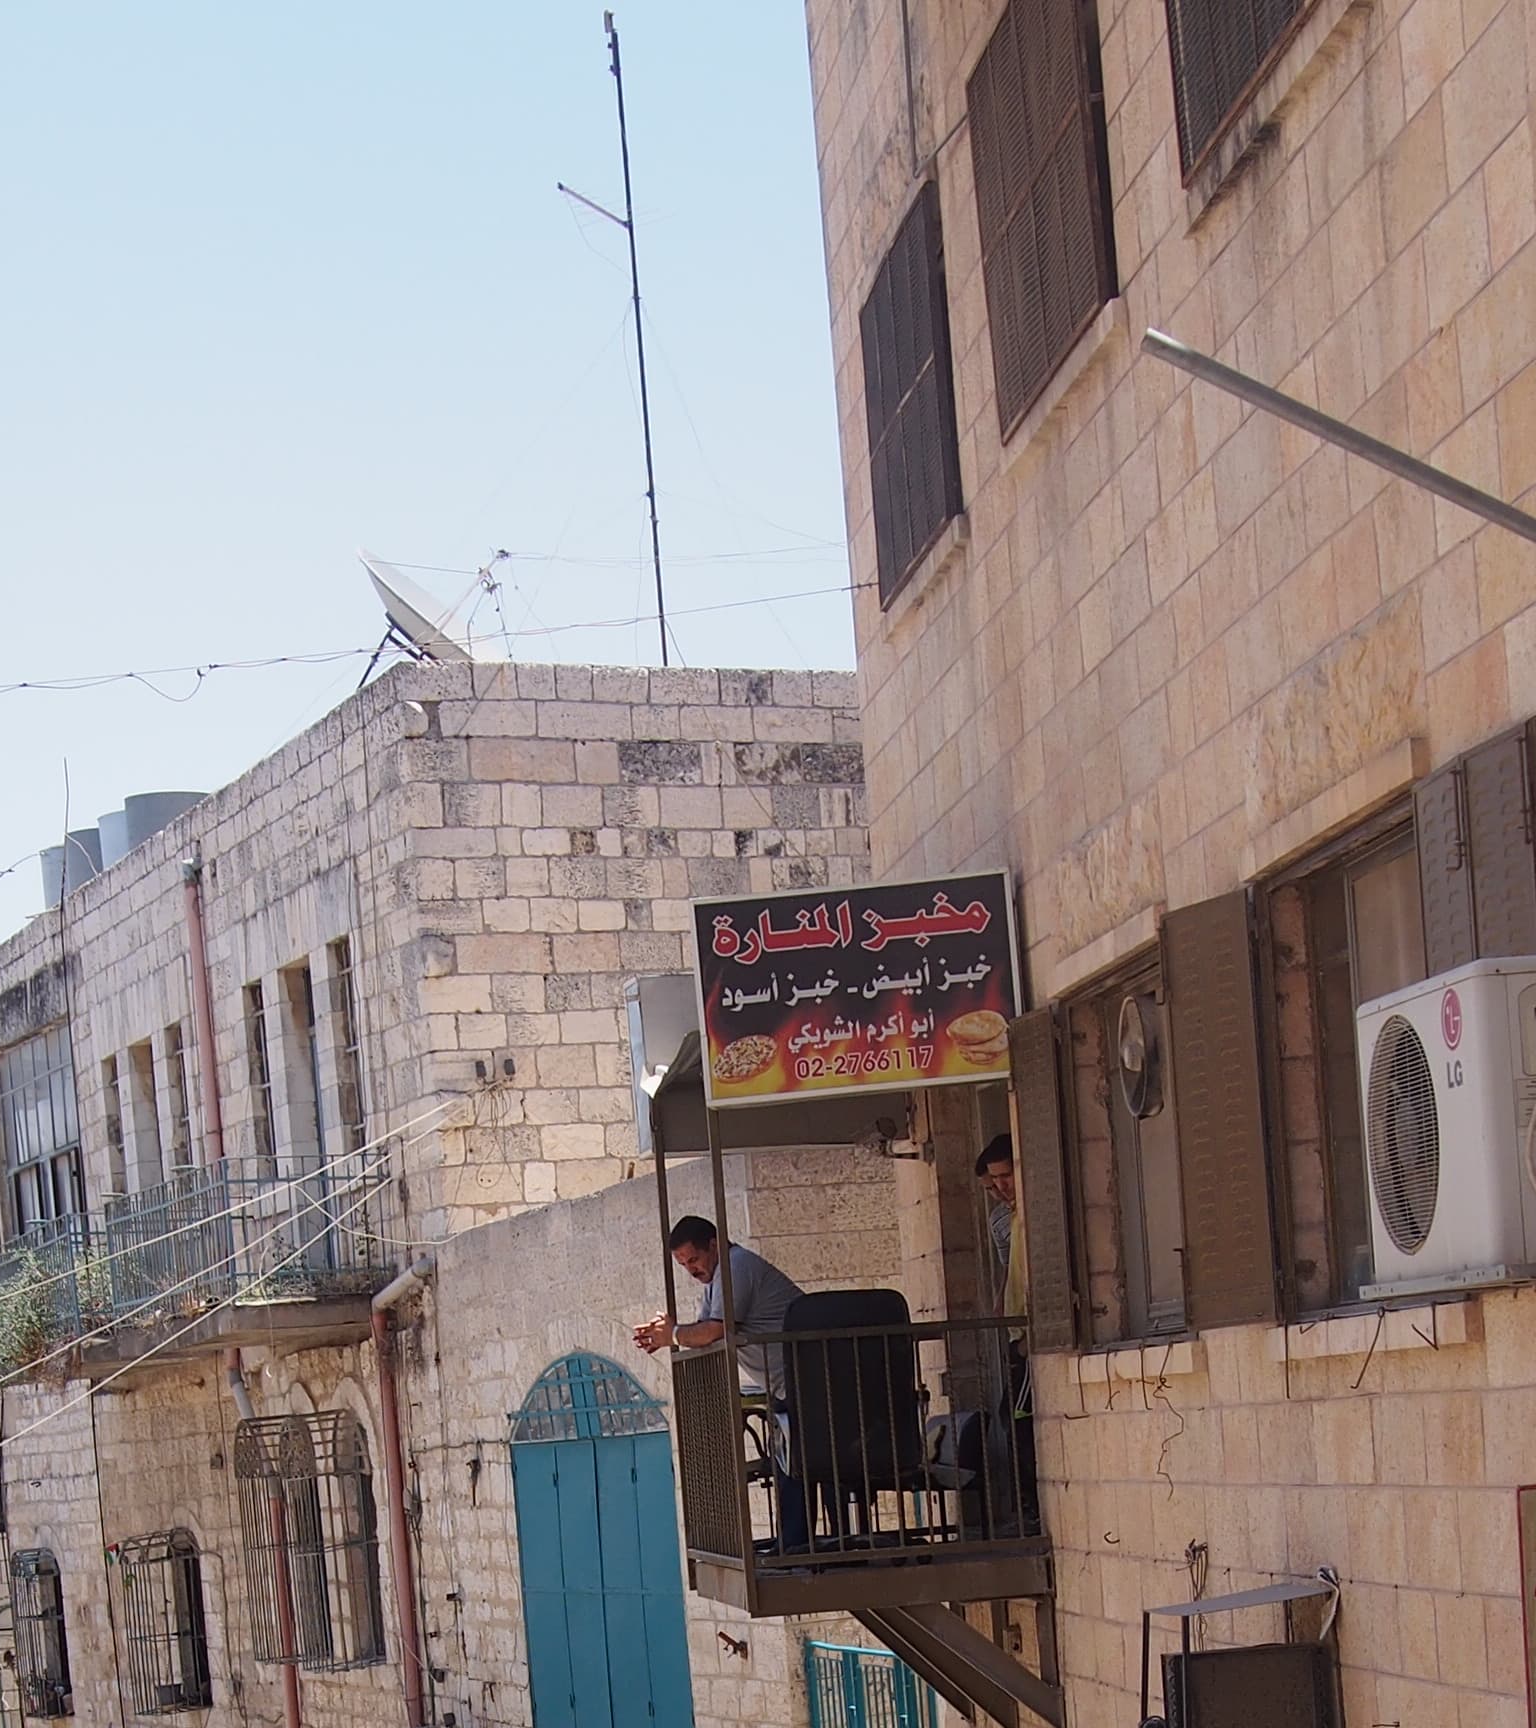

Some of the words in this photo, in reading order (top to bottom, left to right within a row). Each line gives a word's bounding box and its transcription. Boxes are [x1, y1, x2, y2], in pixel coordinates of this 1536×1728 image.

[713, 899, 853, 964] المنارة
[861, 892, 991, 951] مخبز
[785, 968, 839, 1007] خبز
[863, 957, 930, 998] أبيض
[936, 954, 991, 990] خبز
[722, 973, 778, 1012] أسود
[788, 1016, 860, 1052] الشويكي
[866, 1012, 904, 1043] أكرم
[911, 1009, 934, 1038] أبو
[795, 1046, 934, 1081] 02-2766117
[1446, 1061, 1463, 1088] LG
